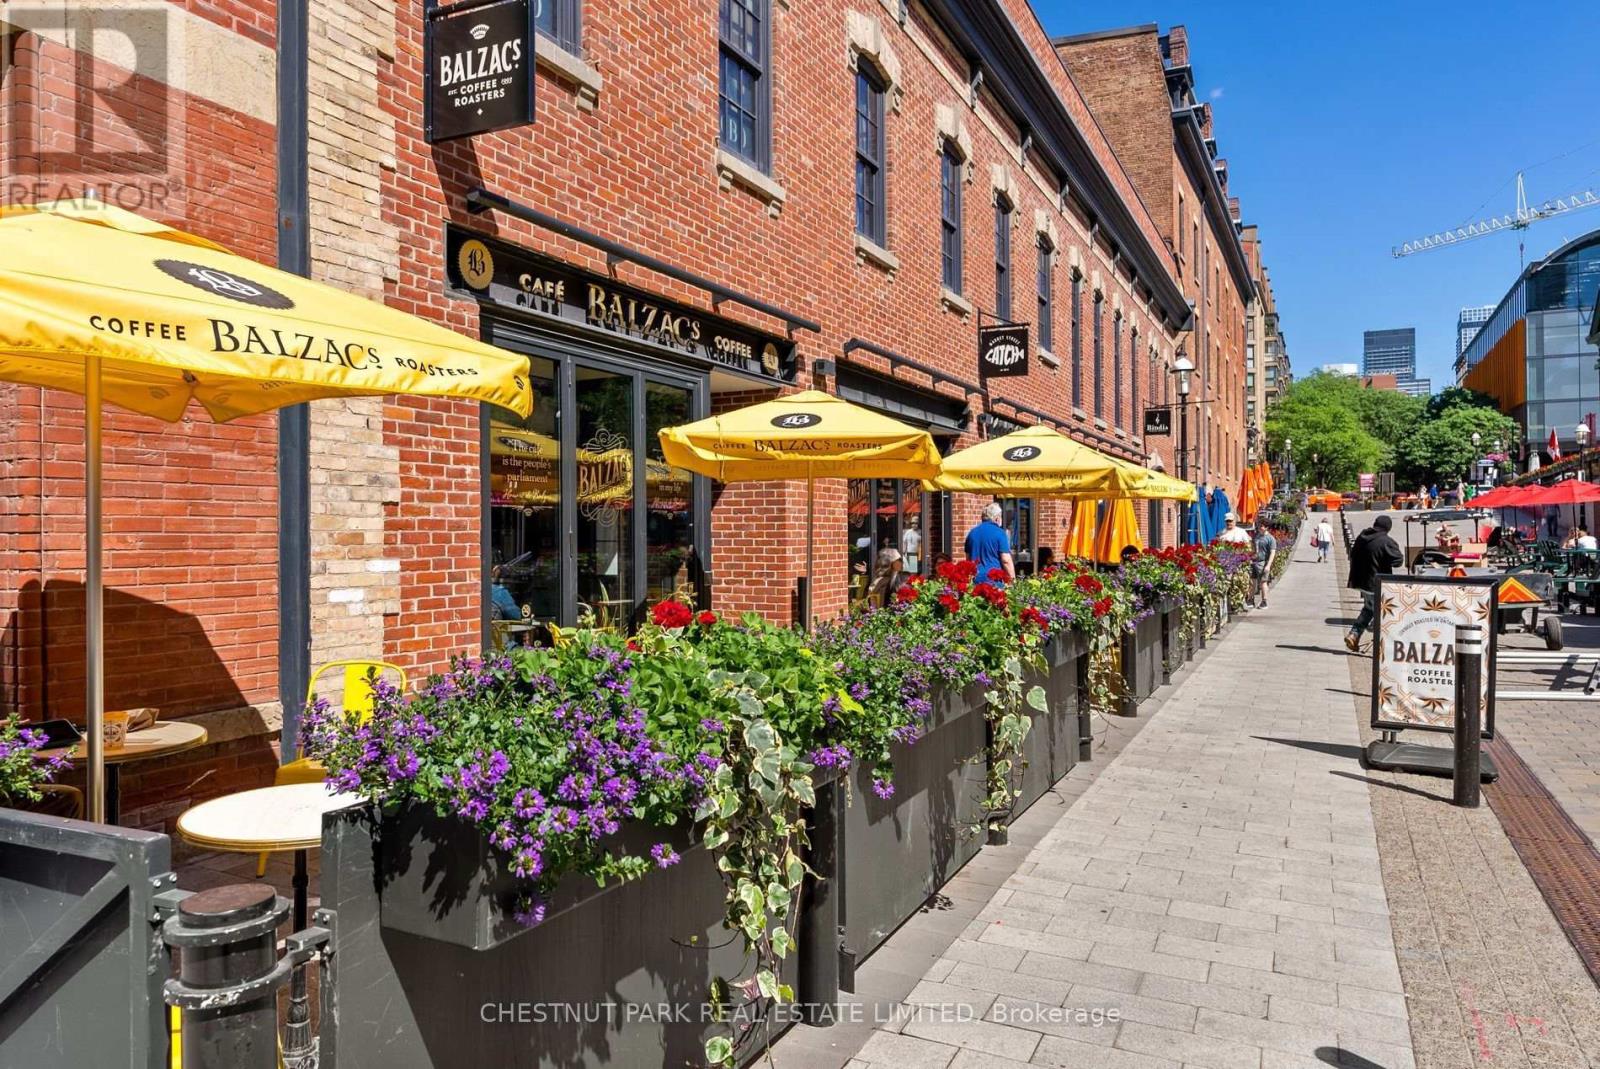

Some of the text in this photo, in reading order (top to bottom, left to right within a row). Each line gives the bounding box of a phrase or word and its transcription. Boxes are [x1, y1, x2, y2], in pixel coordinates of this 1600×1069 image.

[460, 79, 497, 95] COFFEE
[454, 88, 505, 107] ROASTERS
[519, 273, 565, 300] CAFÉ
[714, 336, 752, 359] COFFEE
[90, 315, 187, 341] COFFEE
[395, 356, 479, 377] ROASTERS
[985, 344, 1021, 365] CATCH
[837, 442, 882, 450] ROASTERS
[502, 455, 509, 466] is
[510, 456, 522, 467] the
[1393, 640, 1455, 666] BALZA
[1408, 676, 1456, 686] ROASTER
[1413, 669, 1451, 678] COFFEE
